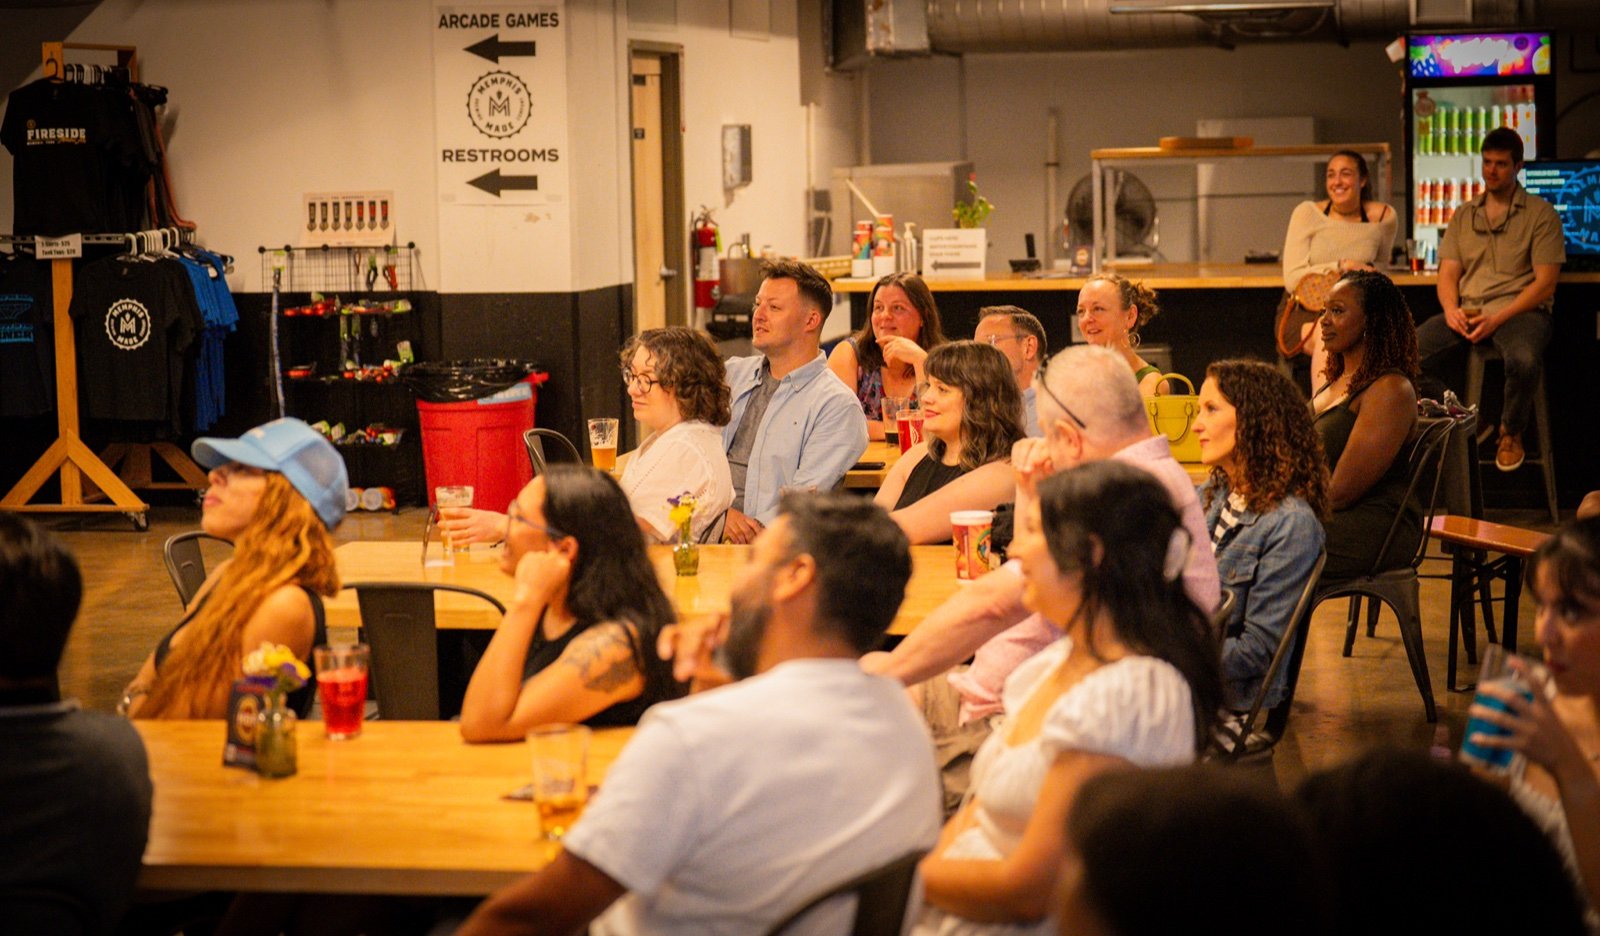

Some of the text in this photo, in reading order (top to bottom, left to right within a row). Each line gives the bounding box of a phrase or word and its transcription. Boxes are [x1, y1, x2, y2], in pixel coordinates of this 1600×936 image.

[438, 12, 560, 29] ARCADE GAMES
[477, 76, 522, 95] MEMPHIS
[26, 128, 87, 140] FIRESIDE
[485, 121, 514, 133] MADE
[441, 148, 560, 163] RESTROOMS
[112, 303, 145, 318] MEMPHIS
[116, 335, 139, 346] MADE
